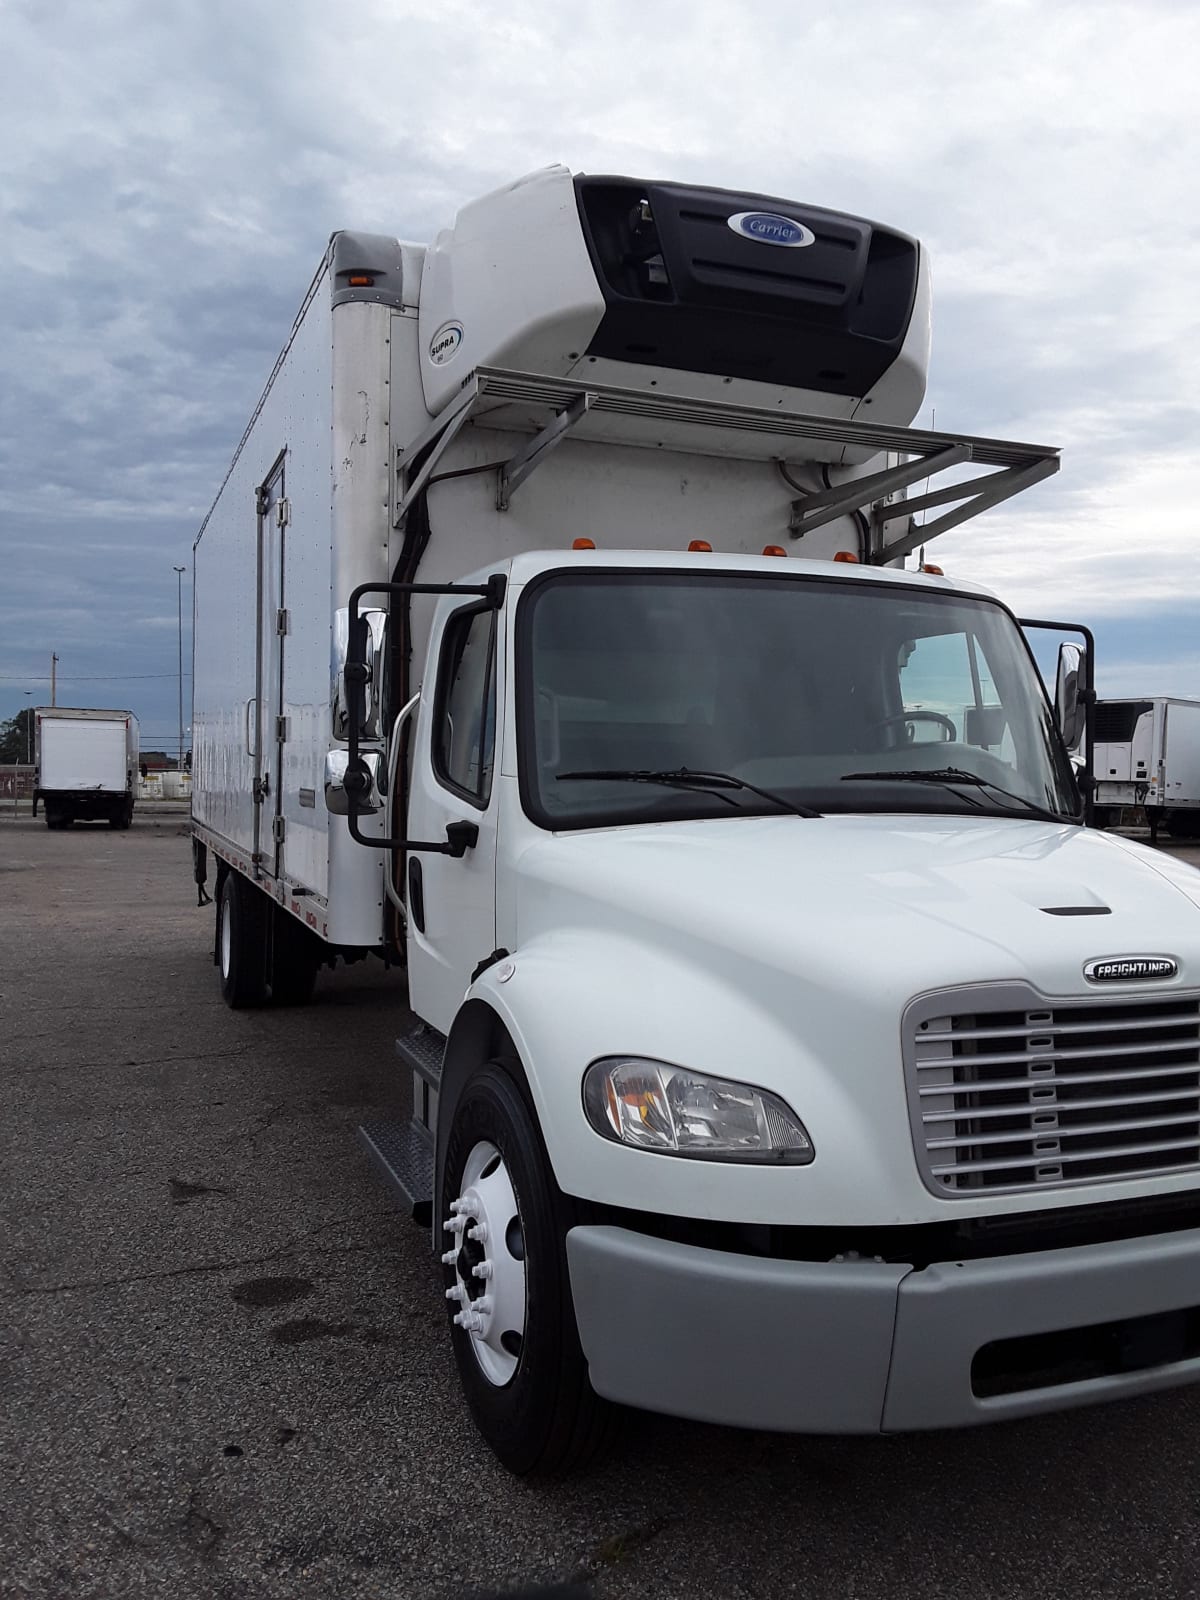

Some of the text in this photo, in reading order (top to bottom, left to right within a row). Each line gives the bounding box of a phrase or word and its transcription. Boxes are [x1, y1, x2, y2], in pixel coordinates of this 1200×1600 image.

[750, 220, 795, 238] Carrier
[431, 335, 455, 357] SUPRA
[1097, 962, 1171, 977] FREIGHTLINER
